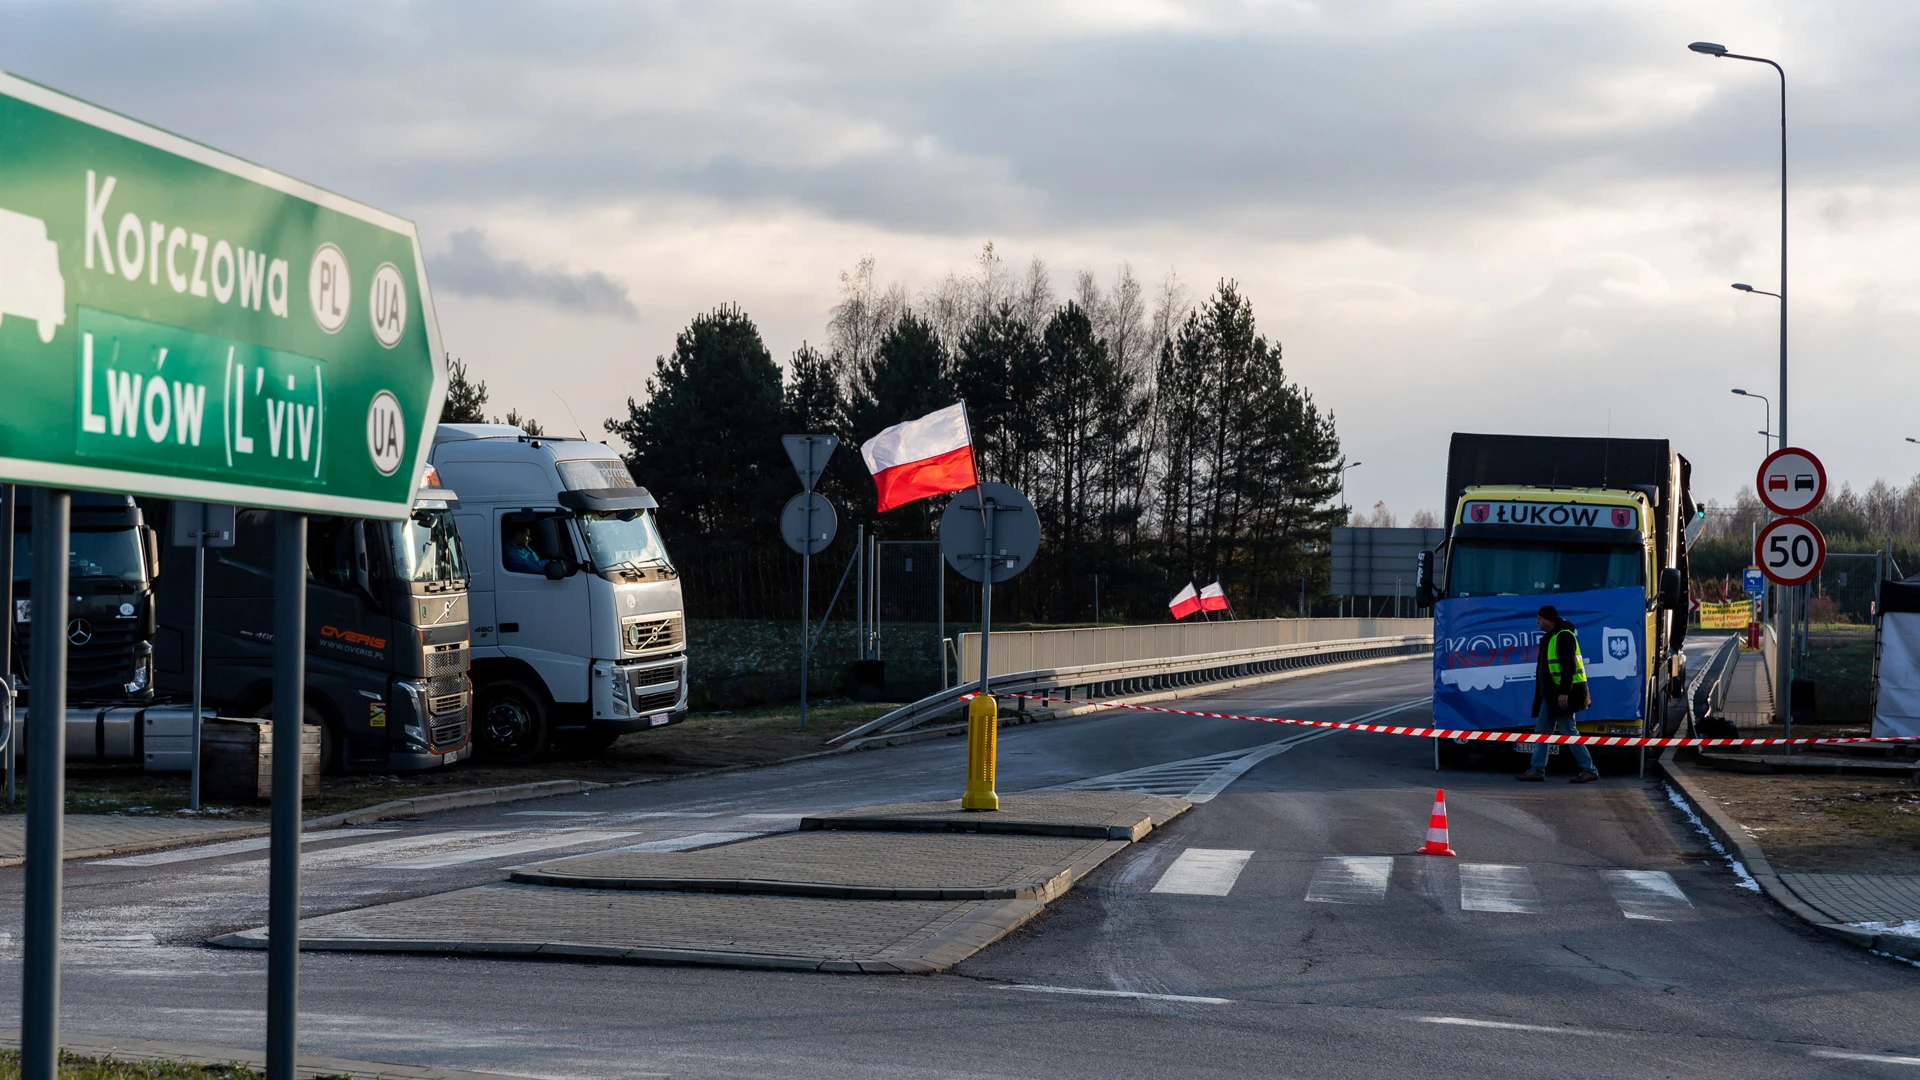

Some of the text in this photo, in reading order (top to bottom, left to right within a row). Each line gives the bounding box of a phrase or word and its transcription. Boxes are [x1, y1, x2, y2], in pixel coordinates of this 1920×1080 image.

[84, 169, 401, 334] Korczowa PL UA
[82, 332, 206, 447] Lwów
[373, 405, 399, 460] UA
[1497, 504, 1599, 527] ŁUKÓW
[1769, 534, 1814, 567] 50
[319, 638, 384, 660] WWW.OVERIS.PL
